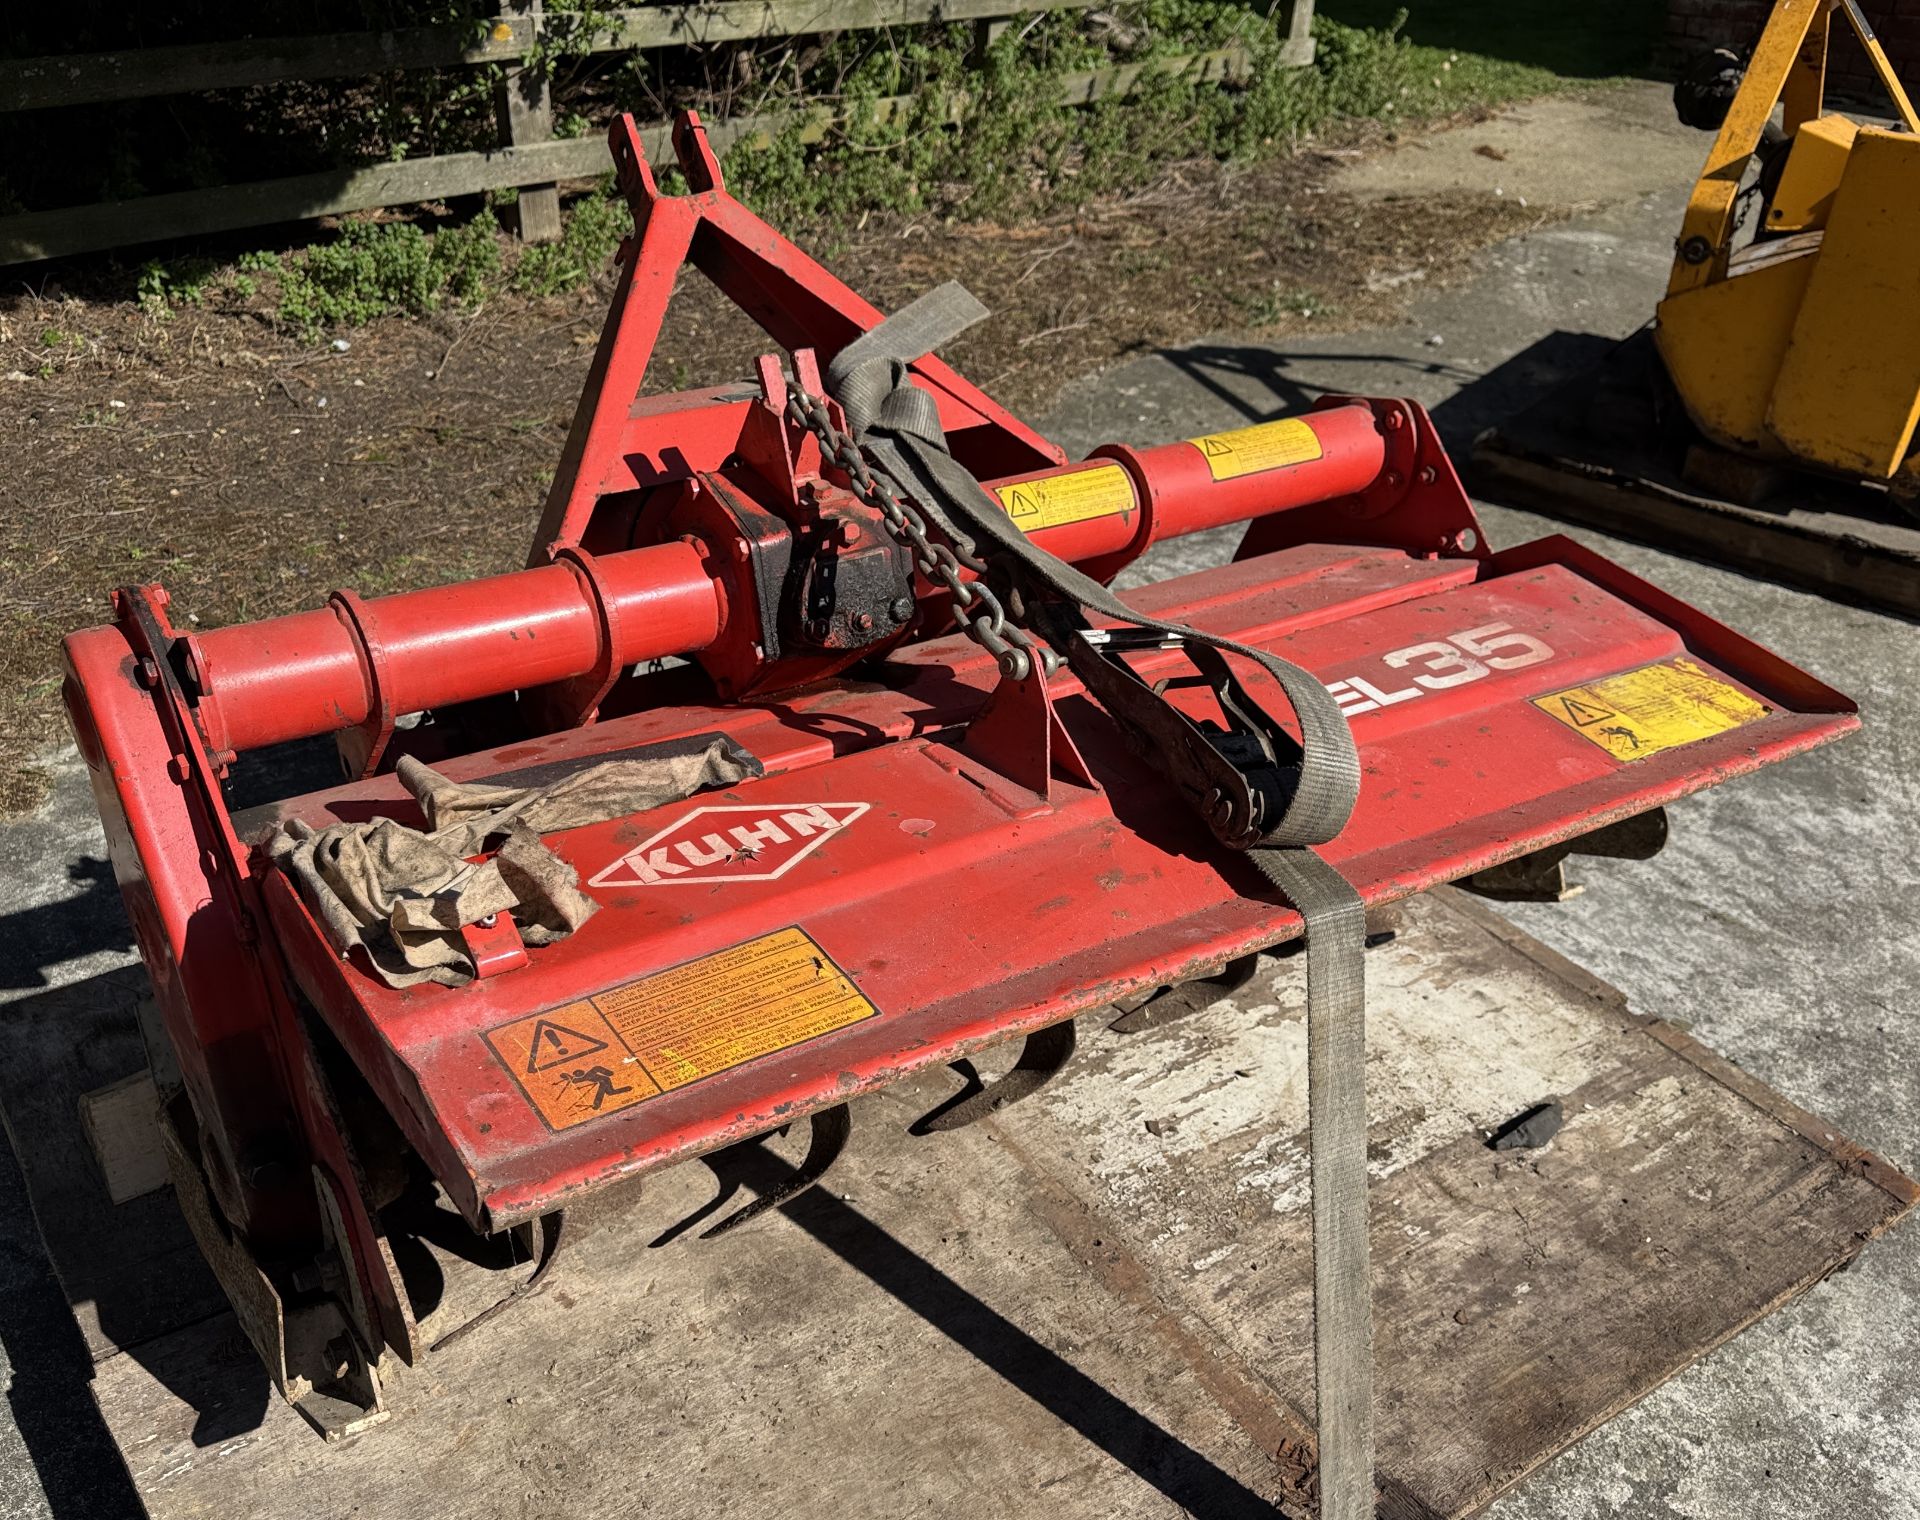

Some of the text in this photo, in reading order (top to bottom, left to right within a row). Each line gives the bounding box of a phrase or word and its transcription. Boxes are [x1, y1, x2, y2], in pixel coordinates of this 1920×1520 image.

[624, 804, 843, 885] KUHN
[718, 947, 747, 959] DANGER
[747, 941, 762, 949] PAR
[613, 974, 729, 1018] WARNING! ROTATING ELEMENTS
[616, 1009, 649, 1023] DANGER
[647, 1004, 664, 1012] DUE
[675, 984, 720, 1002] PROJECTION
[729, 969, 760, 982] FOREIGN
[758, 958, 790, 972] OBJECTS
[620, 1017, 643, 1028] KEEP
[642, 1012, 658, 1020] ALL
[657, 999, 694, 1015] PERSONS
[693, 990, 719, 1001] AWAY
[717, 982, 741, 993] FROM
[740, 976, 756, 985] THE
[755, 965, 787, 979] DANGER
[636, 976, 680, 993] PROJECTION
[690, 963, 715, 974] CORPS
[646, 985, 671, 996] TOUTE
[670, 970, 712, 987] PERSONNE
[733, 955, 754, 965] ZONE
[627, 1018, 672, 1037] VORSICHT!
[748, 981, 776, 993] GEFAHR
[775, 972, 802, 983] DURCH
[635, 1028, 680, 1047] PERSONEN
[678, 1022, 696, 1031] AUS
[695, 1014, 716, 1024] DEM
[714, 990, 785, 1017] GEFAHRENBEREICH
[706, 1059, 731, 1071] TODA
[730, 1046, 768, 1062] PERSONA
[789, 1029, 813, 1041] ZONA
